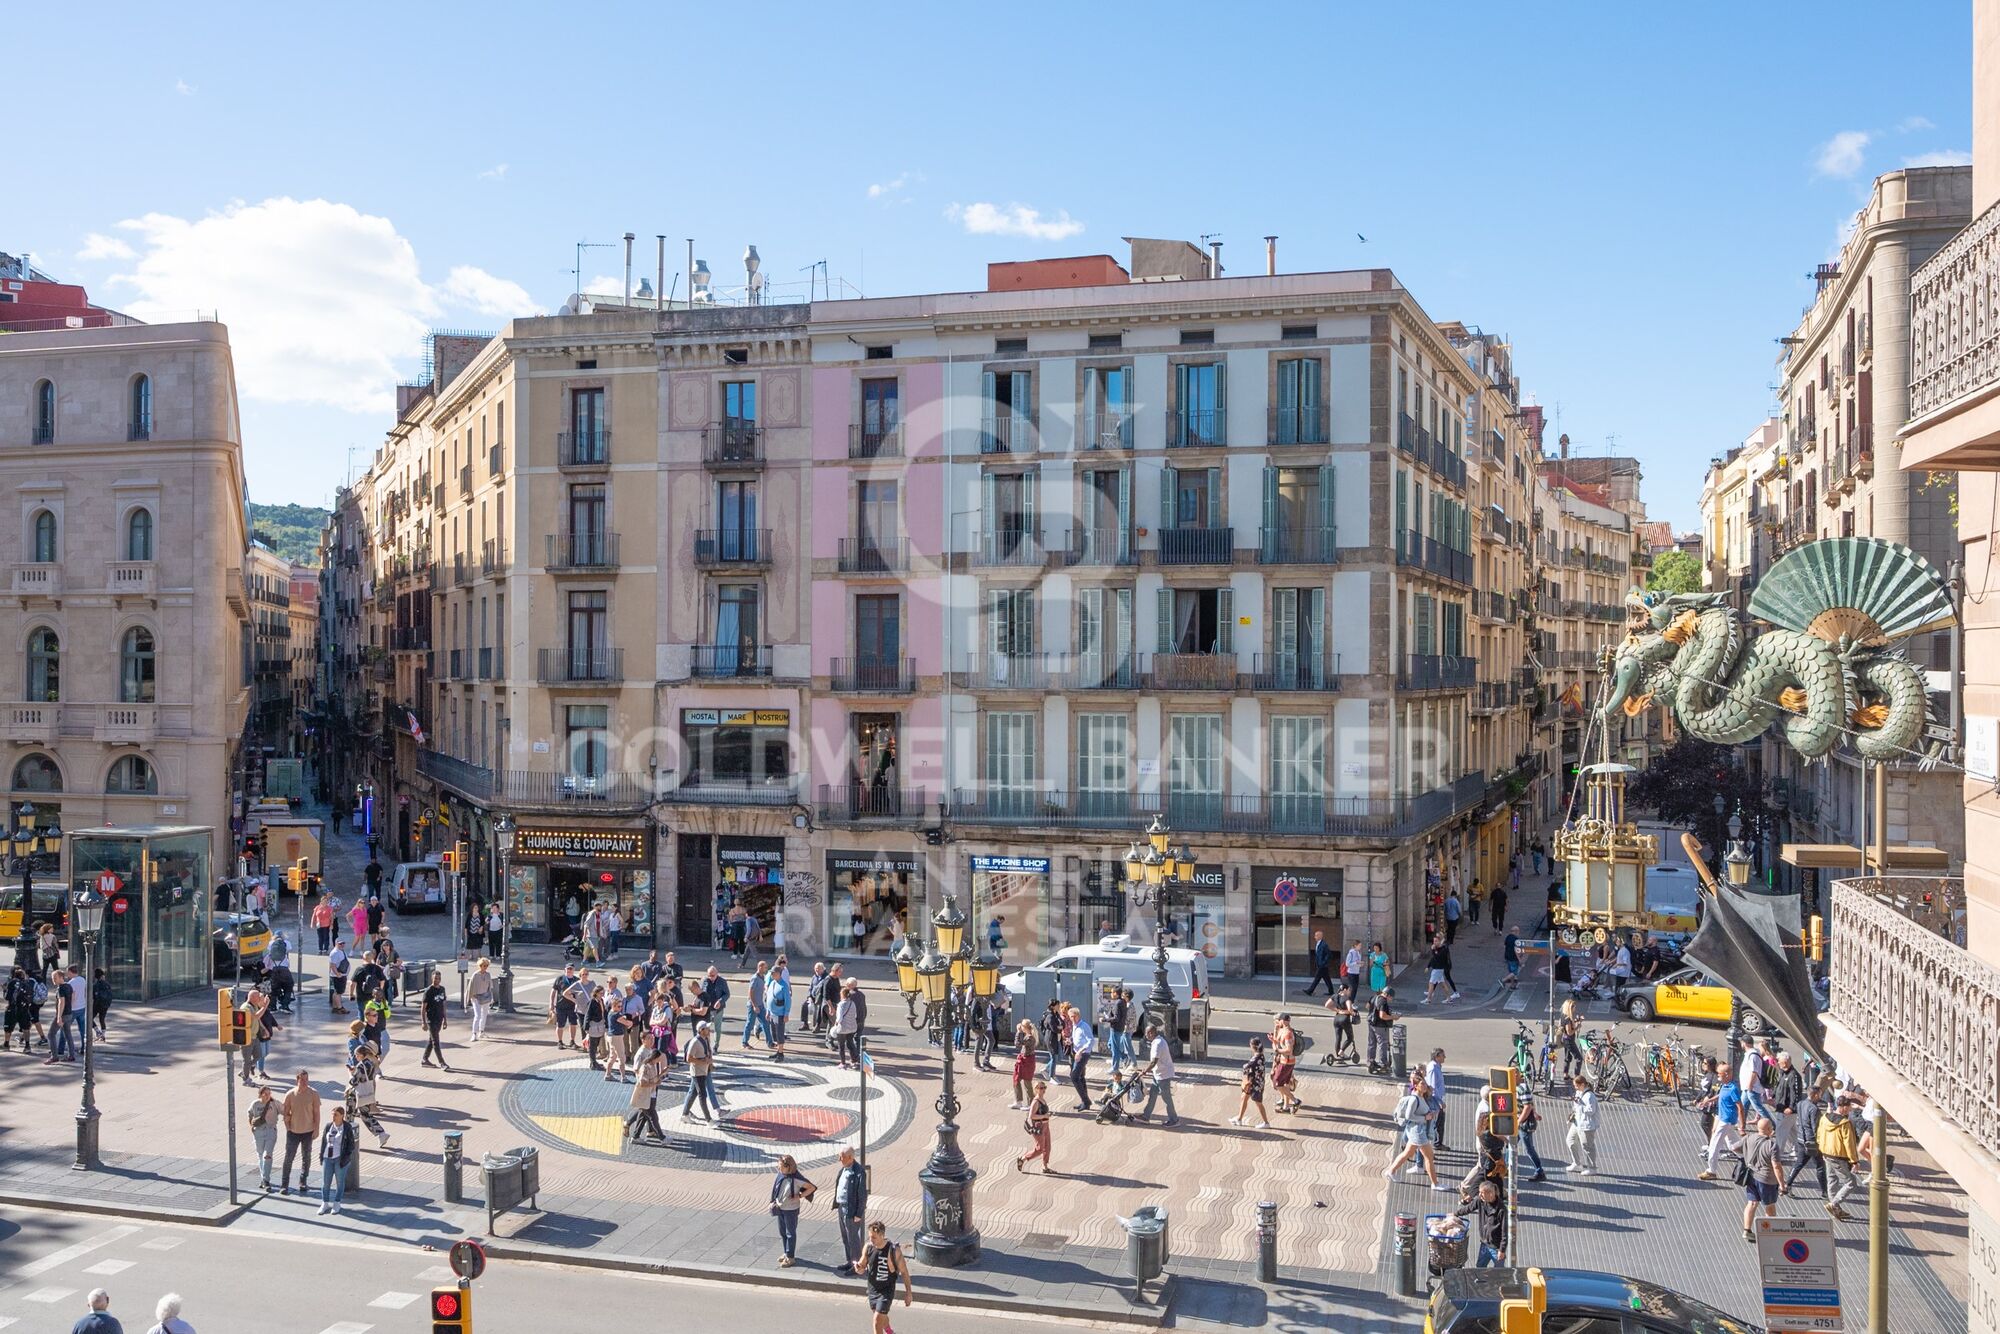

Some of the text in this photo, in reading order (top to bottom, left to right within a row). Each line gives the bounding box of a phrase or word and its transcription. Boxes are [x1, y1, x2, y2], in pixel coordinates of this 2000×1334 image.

[690, 713, 789, 722] HOSTAL MARE NOSTRUM
[526, 836, 633, 852] HUMMUS & COMPANY
[721, 850, 782, 862] SOUVENIRS SPORTS
[834, 860, 919, 870] BARCELONA IS MY STYLE
[973, 857, 1048, 868] THE PHONE SHOP
[101, 876, 115, 891] M
[1169, 872, 1223, 885] CANGE
[1790, 1221, 1806, 1229] DUM
[876, 1256, 889, 1282] RUN
[1813, 1318, 1835, 1328] 4751
